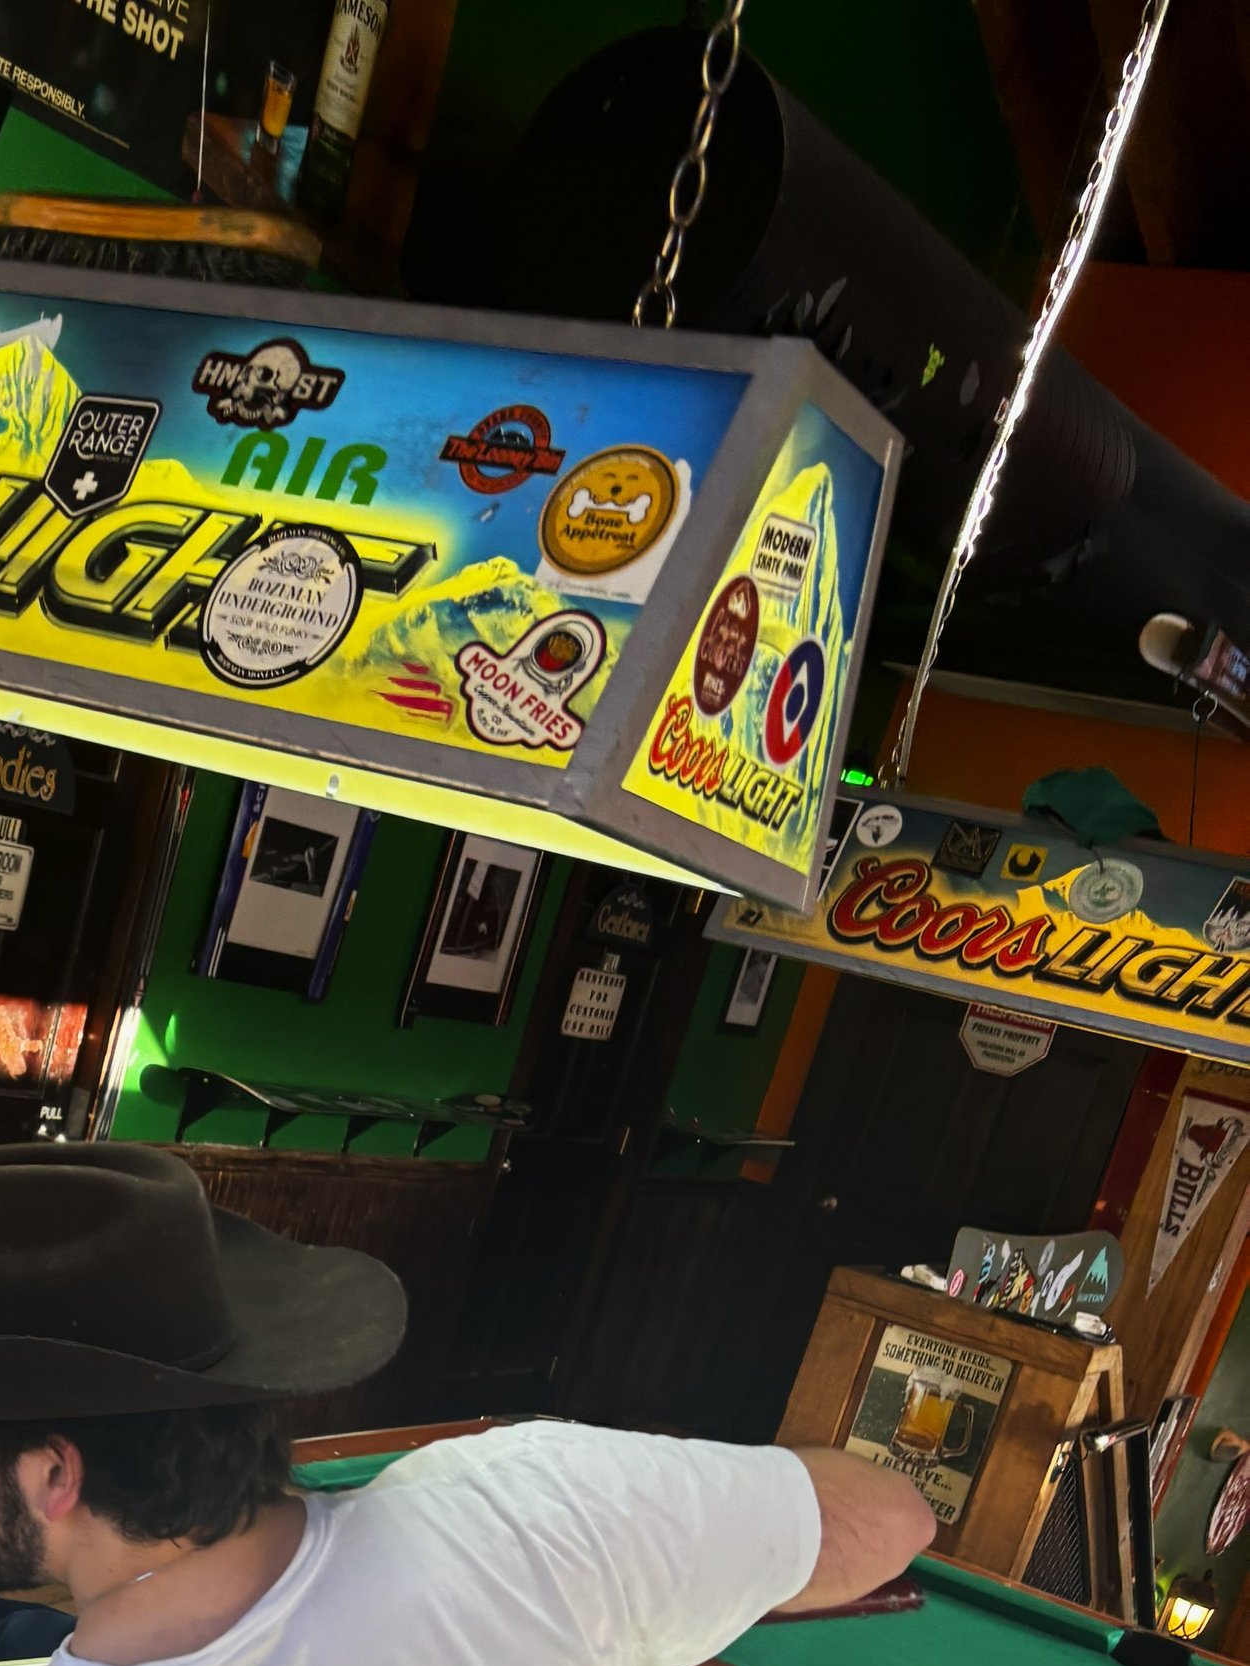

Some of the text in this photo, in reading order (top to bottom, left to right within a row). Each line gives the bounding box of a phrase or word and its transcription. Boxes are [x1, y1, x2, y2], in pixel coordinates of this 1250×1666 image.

[75, 0, 117, 24] HE
[122, 1, 184, 60] SHOT
[12, 65, 86, 120] RESPONSIBLY.
[78, 411, 144, 436] OUTER
[69, 430, 139, 460] RANGE
[221, 431, 388, 506] AIR
[584, 512, 623, 528] Bone
[762, 525, 811, 560] MODERN
[756, 553, 804, 583] SKATE PARK
[248, 577, 327, 606] BOZEMAN
[219, 591, 338, 629] UNDERGROUND
[466, 651, 524, 701] MOON
[519, 694, 573, 740] FRIES
[649, 694, 804, 832] Coors LIGHT
[828, 856, 1250, 1024] Coors LIGH
[590, 990, 608, 1003] FOR
[564, 1020, 610, 1036] USE ONLY
[972, 1022, 1041, 1047] PRIVATE PROPERTY
[40, 1105, 62, 1120] PULL
[1163, 1157, 1205, 1237] BULLS
[907, 1334, 958, 1358] EVERYONE
[883, 1342, 1005, 1393] SOMETHING TO BELIEVE IN
[873, 1453, 879, 1463] I
